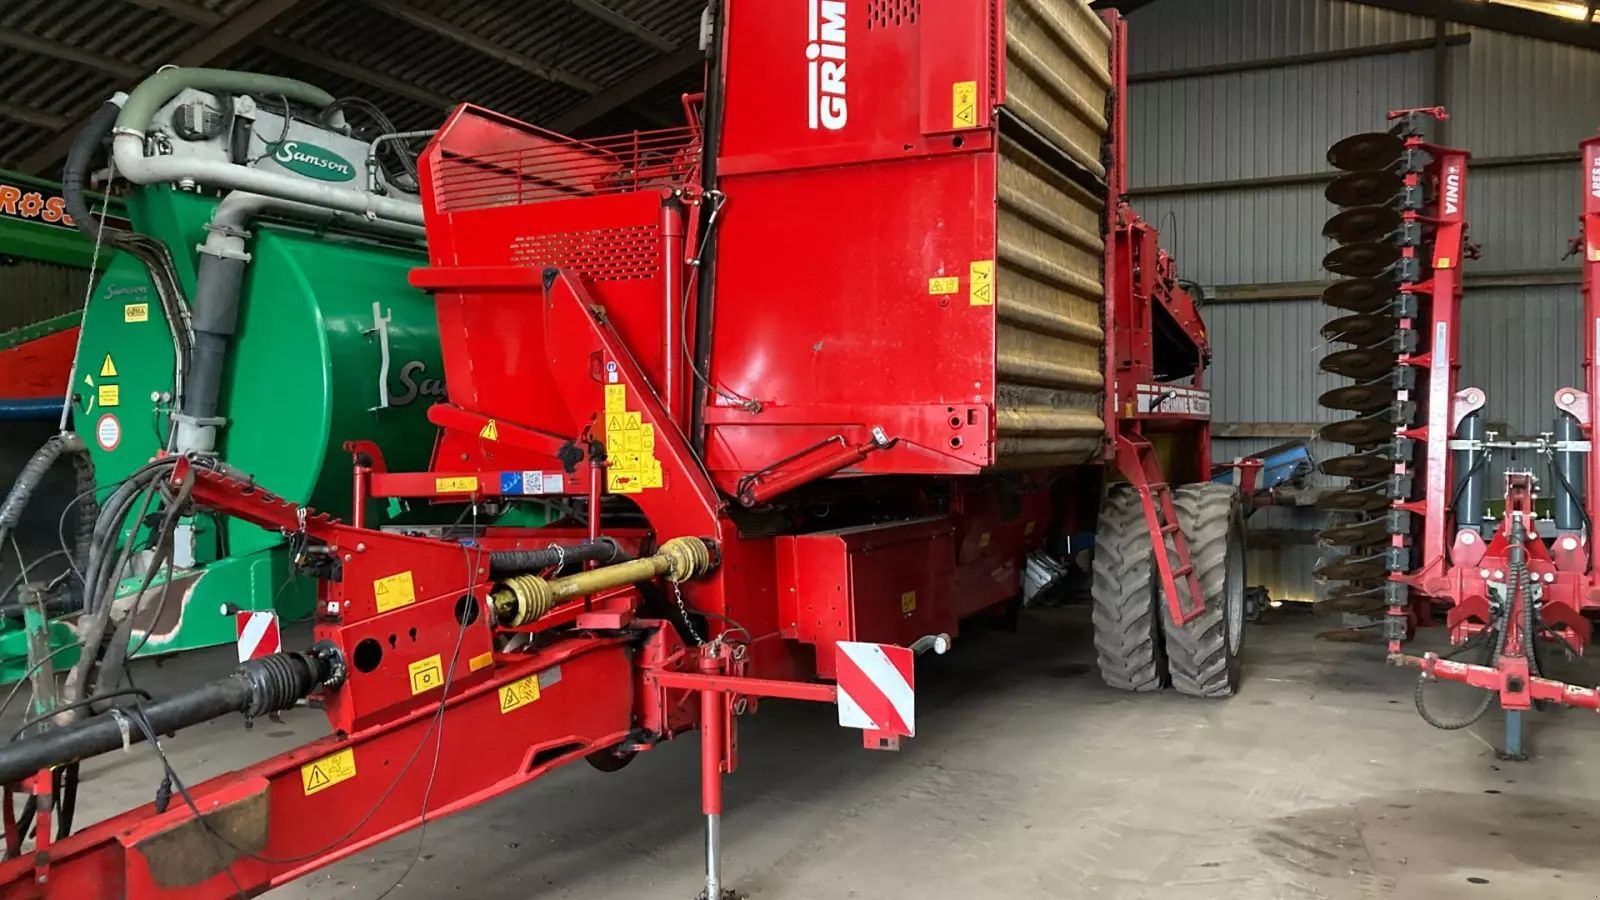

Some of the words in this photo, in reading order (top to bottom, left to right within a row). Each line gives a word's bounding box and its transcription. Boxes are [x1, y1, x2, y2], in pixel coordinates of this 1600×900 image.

[276, 142, 349, 174] Samson
[1445, 174, 1459, 215] UNIA
[388, 361, 446, 405] Sa
